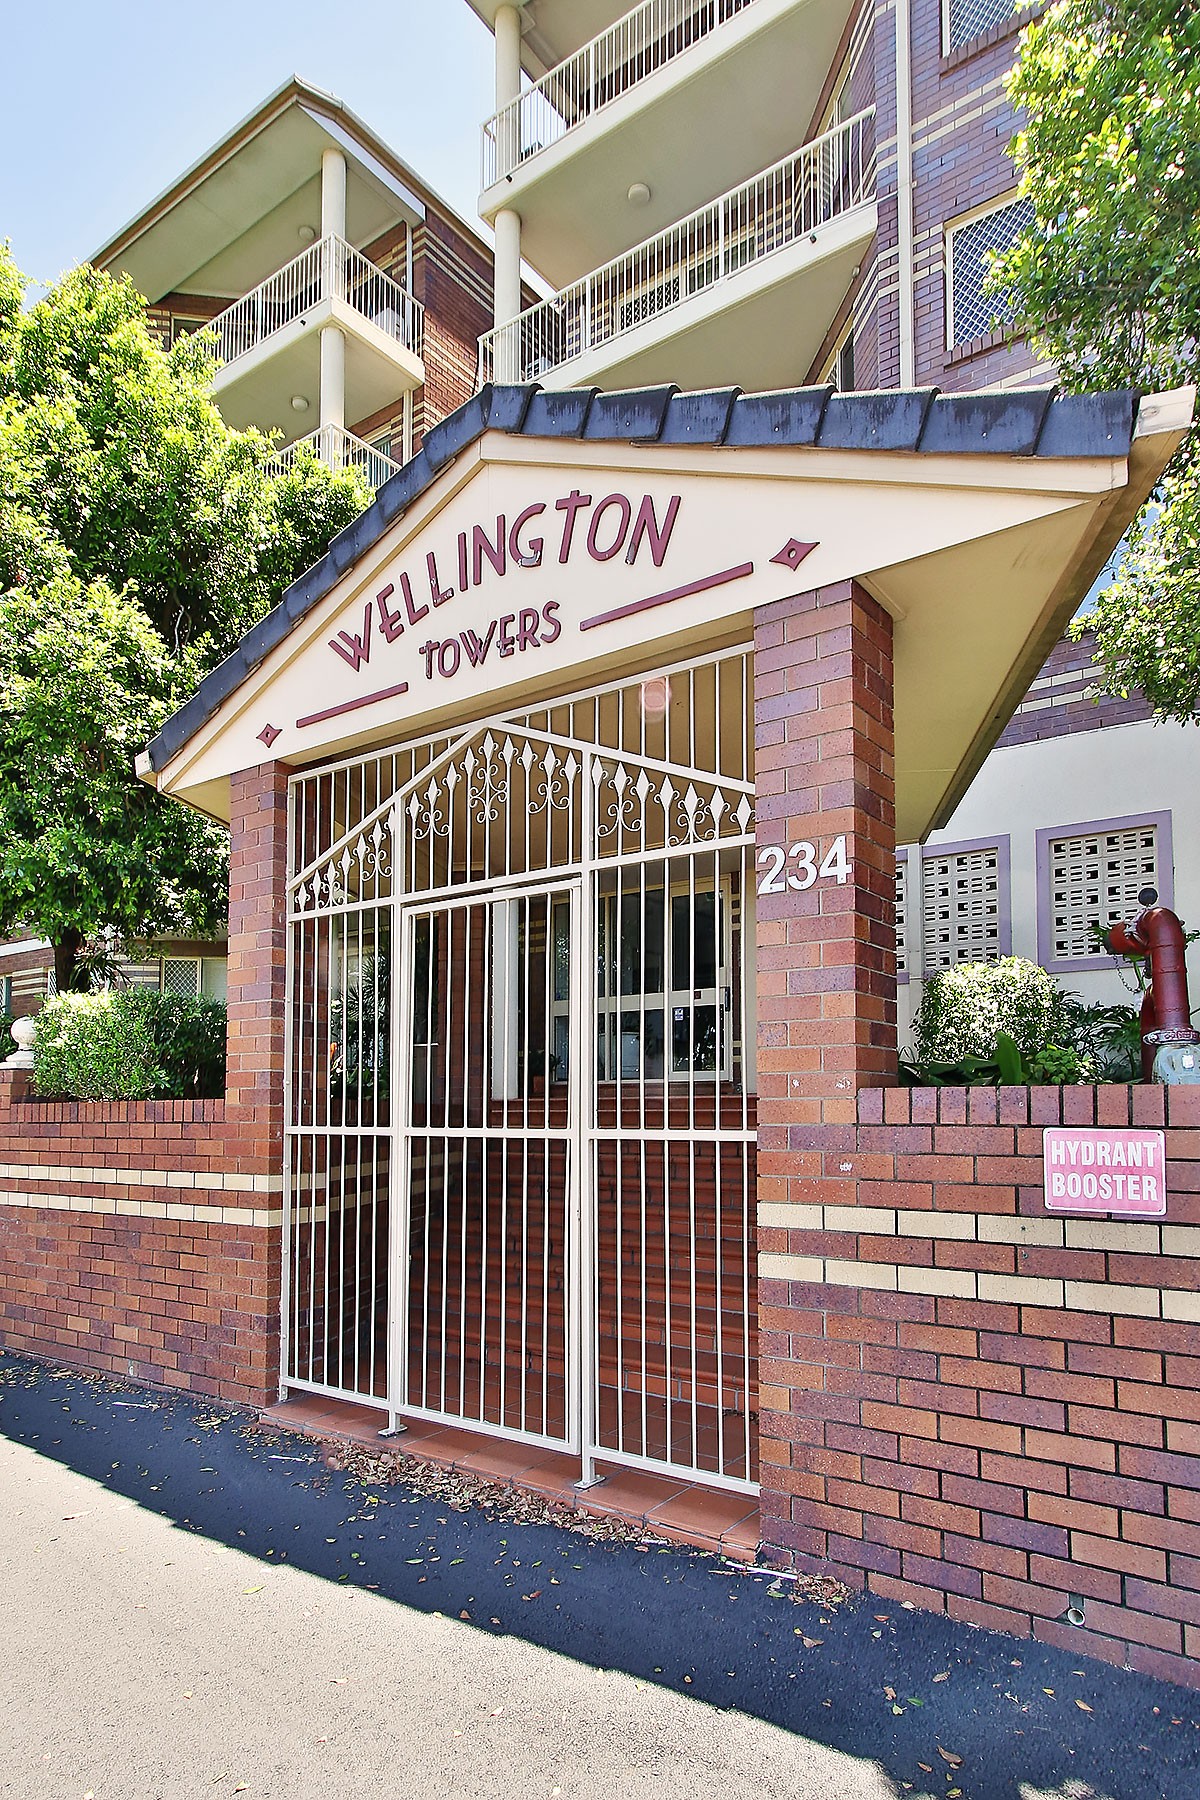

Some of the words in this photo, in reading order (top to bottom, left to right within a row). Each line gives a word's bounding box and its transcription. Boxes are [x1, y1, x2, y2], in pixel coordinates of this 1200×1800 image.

[329, 490, 681, 672] WELLINGTON
[420, 601, 562, 679] TOWERS
[757, 835, 853, 895] 234
[1051, 1140, 1158, 1168] HYDRANT
[1052, 1173, 1158, 1201] BOOSTER
